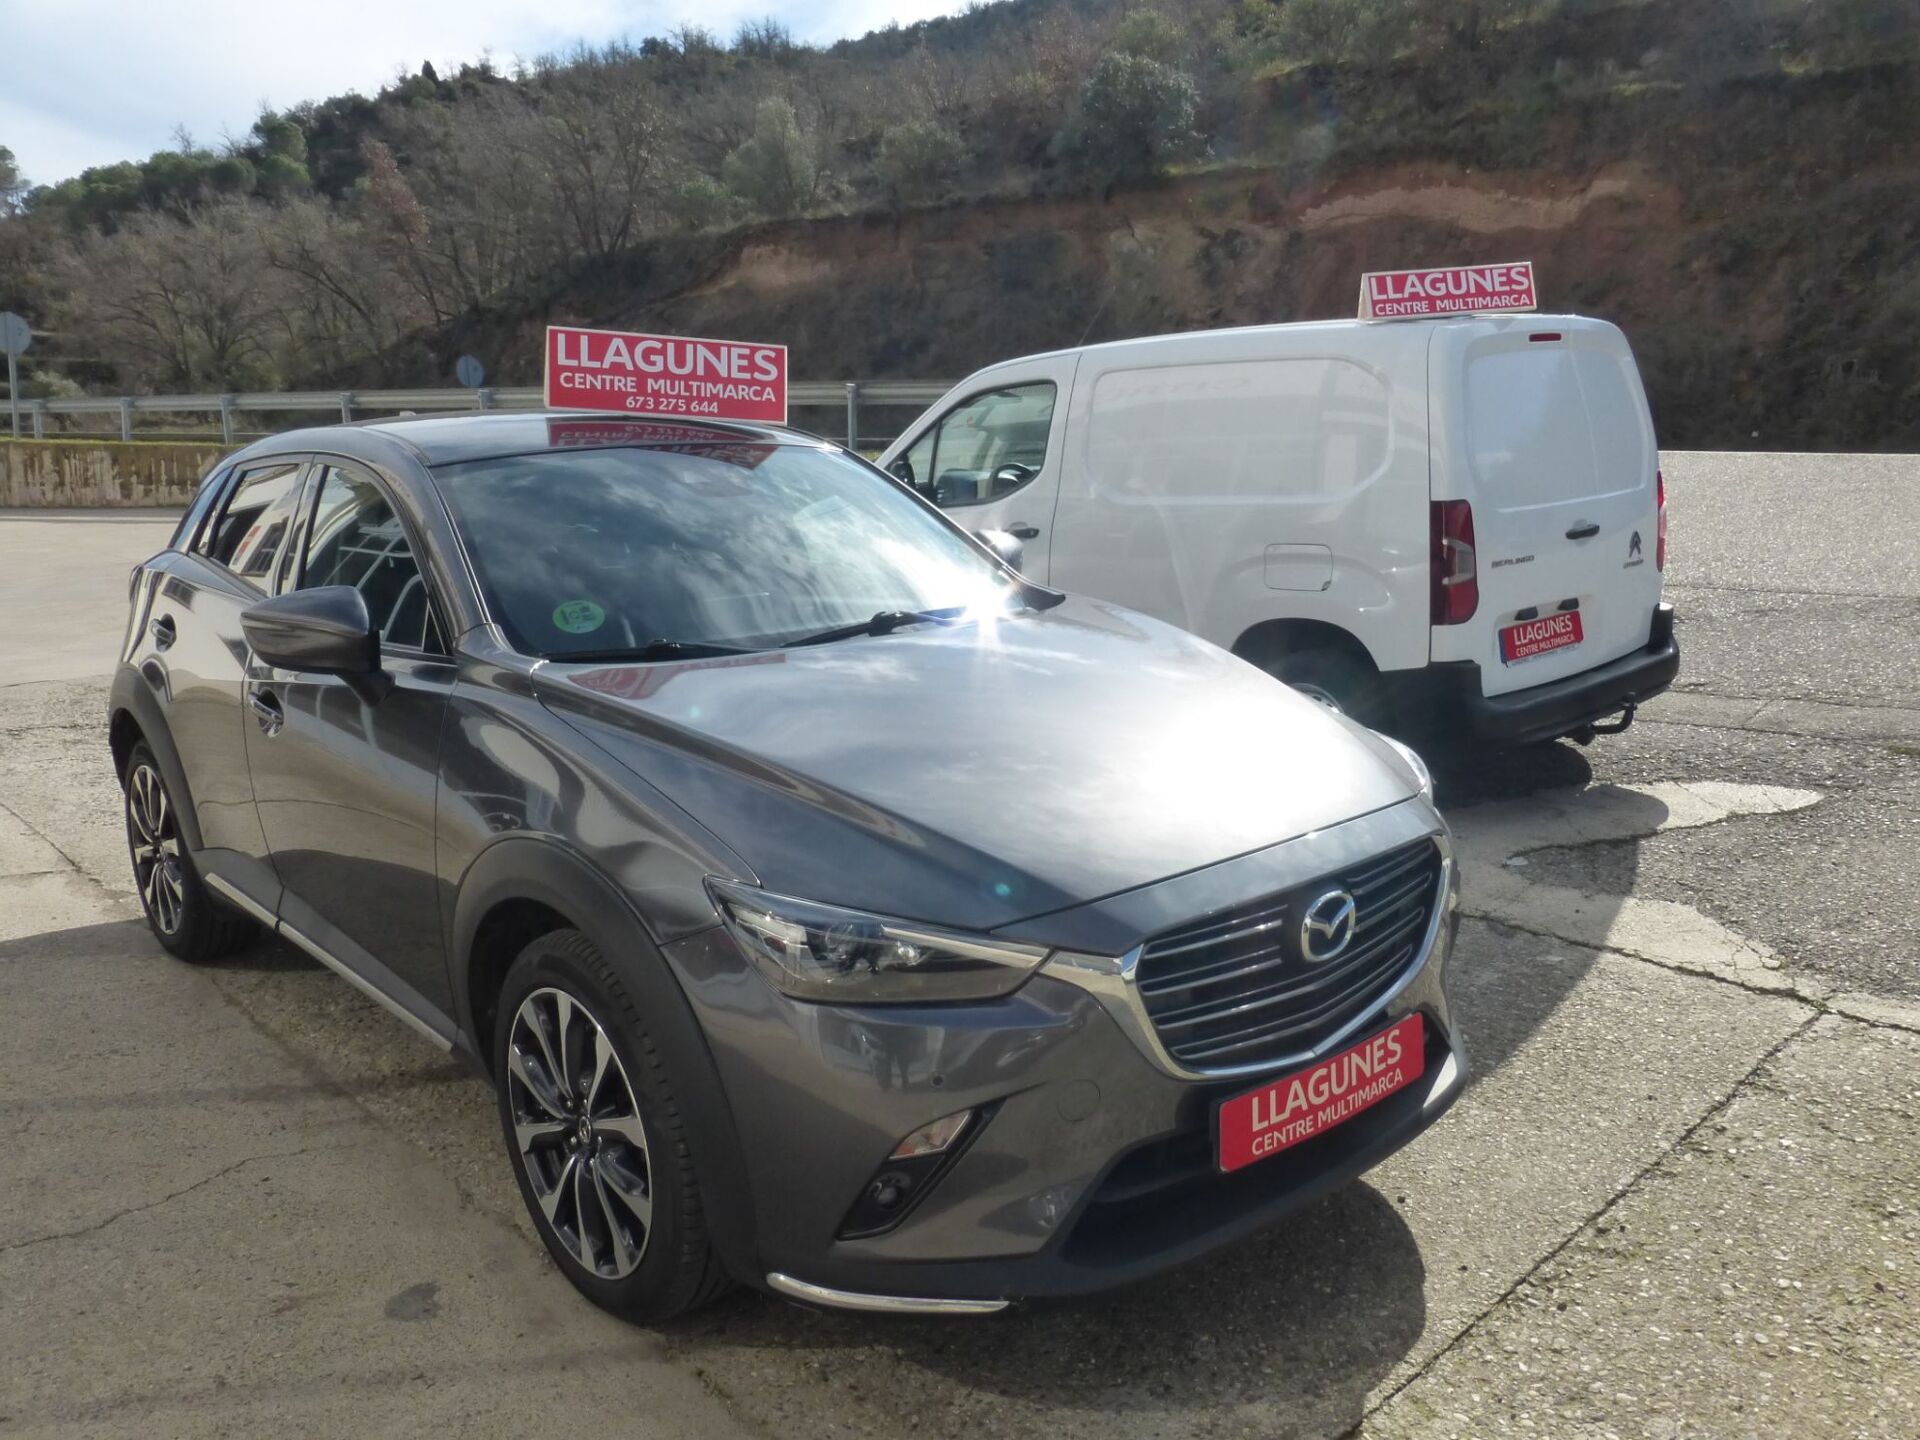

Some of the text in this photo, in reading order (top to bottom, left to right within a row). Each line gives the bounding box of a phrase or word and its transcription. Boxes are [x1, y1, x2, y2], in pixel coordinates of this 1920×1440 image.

[1370, 267, 1529, 300] LLAGUNES
[1375, 294, 1530, 316] CENTRE MULTIMARCA
[557, 333, 778, 381] LLAGUNES
[560, 372, 776, 402] CENTRE MULTIMARCA
[626, 396, 718, 414] 673 275 644
[1513, 615, 1573, 645] LLAGUNES
[1516, 633, 1575, 657] CENTRE MULTIMARCA
[1252, 1028, 1402, 1132] LLAGUNES
[1252, 1068, 1403, 1156] CENTRE MULTIMARCA
